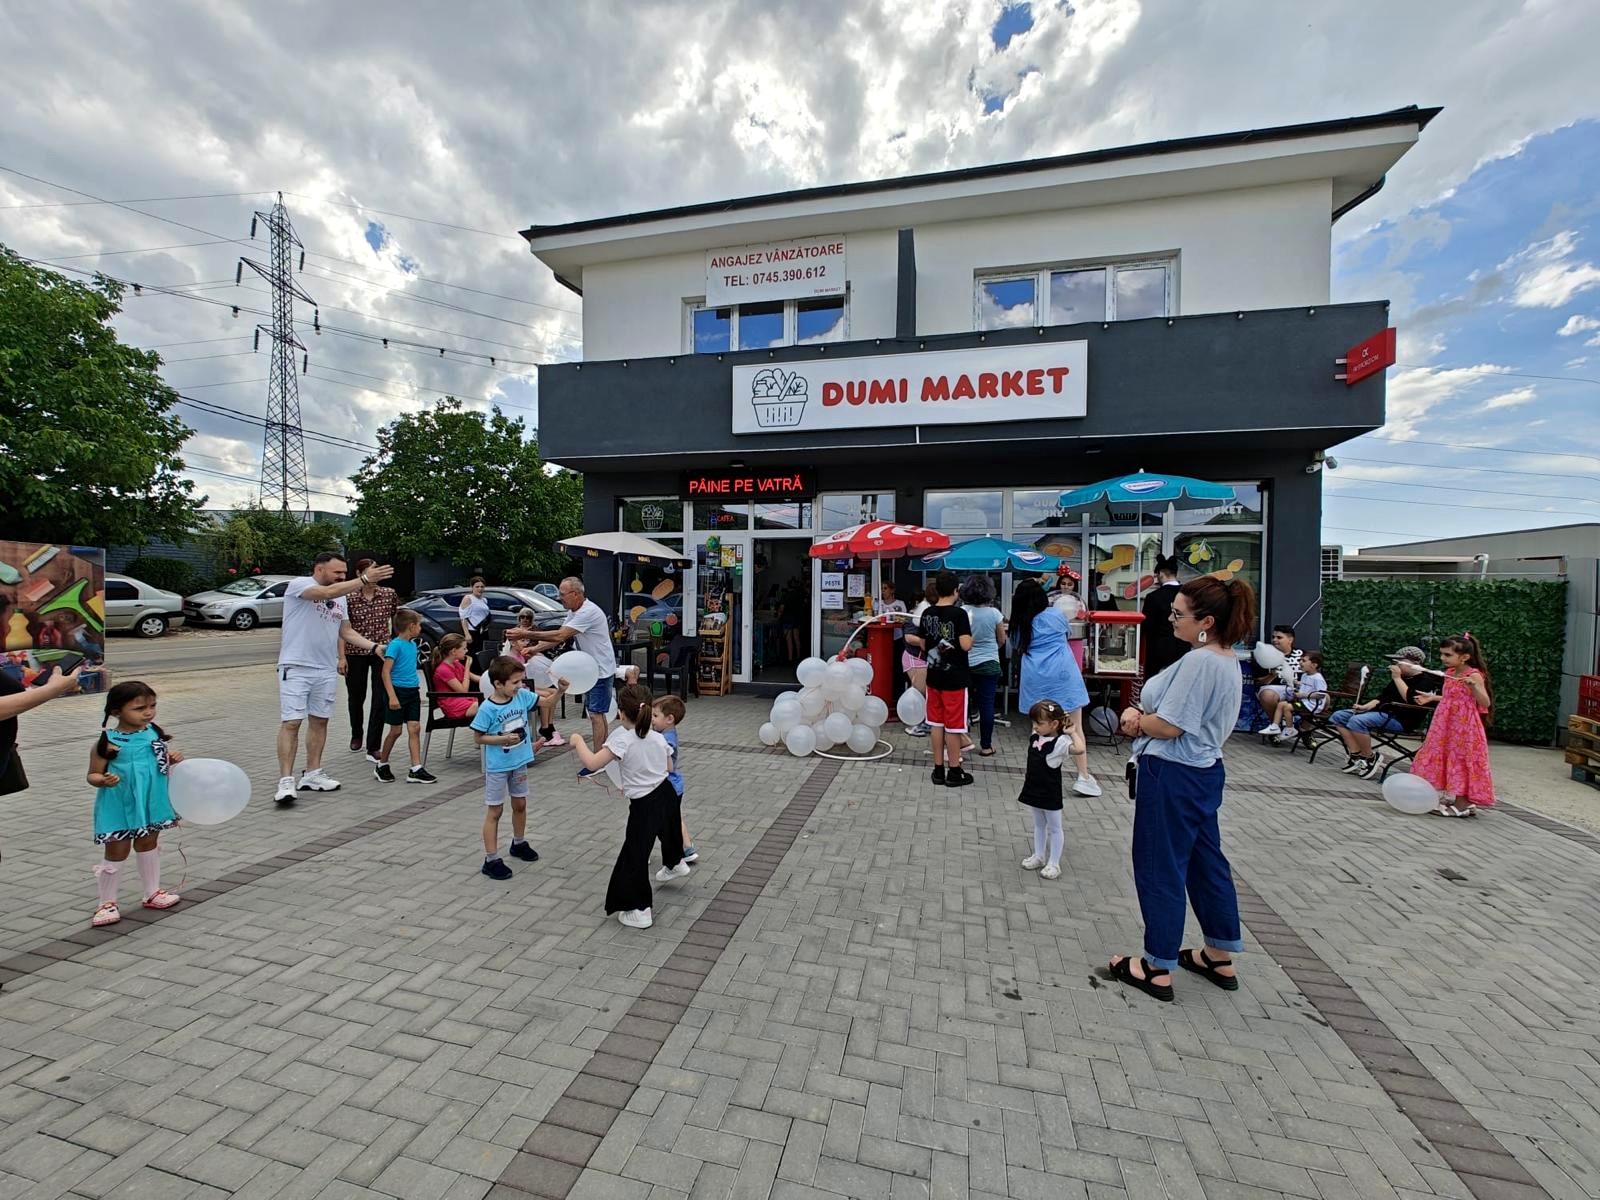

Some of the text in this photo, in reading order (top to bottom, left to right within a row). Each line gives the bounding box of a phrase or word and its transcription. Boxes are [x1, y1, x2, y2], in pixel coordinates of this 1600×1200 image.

[711, 243, 843, 269] ANGAJEZ VÂNZĂTOARE
[724, 265, 826, 286] TEL: 0745.390.612
[821, 367, 1070, 406] DUMI MARKET
[689, 474, 803, 493] PÂINE PE VATRĂ
